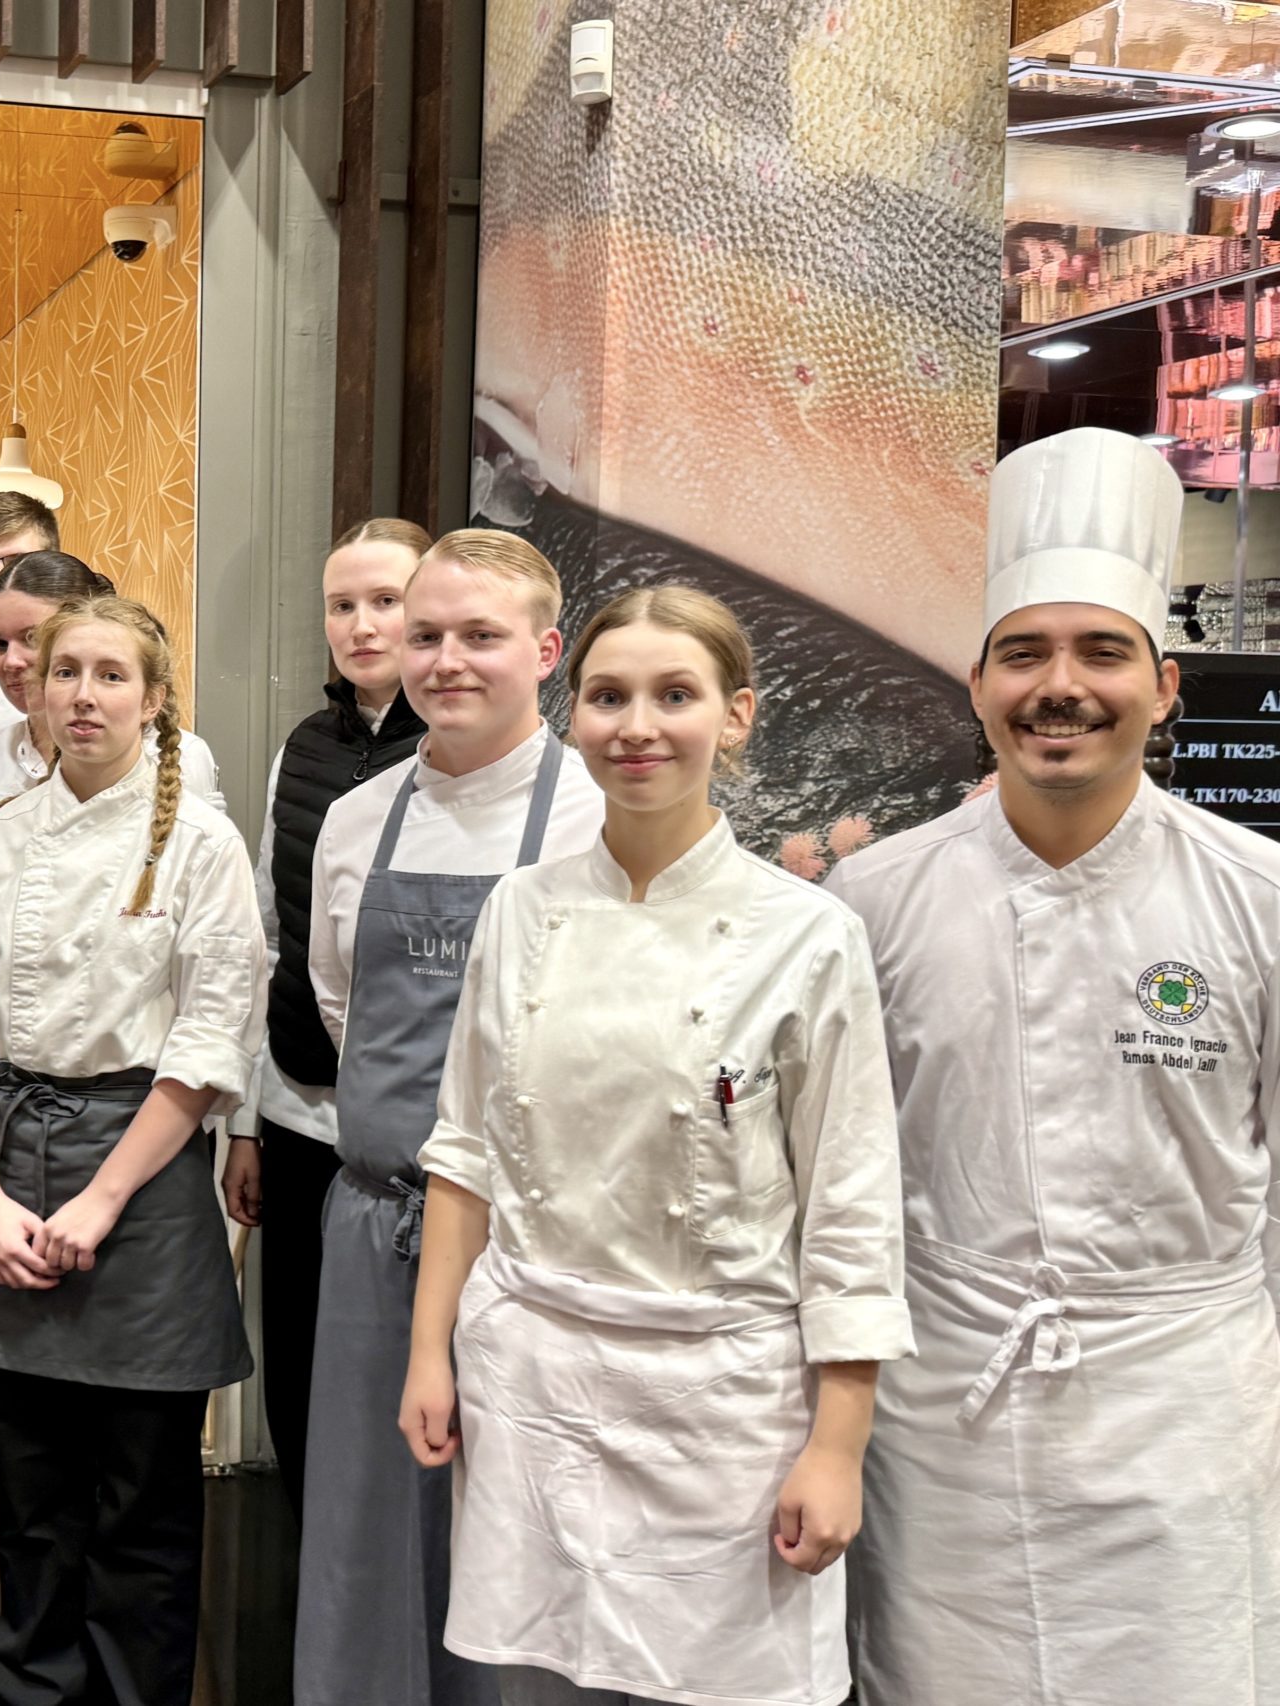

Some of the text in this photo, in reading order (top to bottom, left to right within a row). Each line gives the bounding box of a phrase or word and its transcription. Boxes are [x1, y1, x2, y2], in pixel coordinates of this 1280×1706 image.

[408, 937, 466, 960] LUMI
[413, 967, 459, 978] RESTAURANT
[1139, 964, 1169, 991] VERBAND
[1172, 964, 1189, 972] DER
[1142, 999, 1203, 1023] DEUTSCHLANDS
[1114, 1030, 1227, 1053] Jean Franco Ignacio
[1122, 1050, 1156, 1064] Ramos
[1161, 1053, 1193, 1069] Abdel
